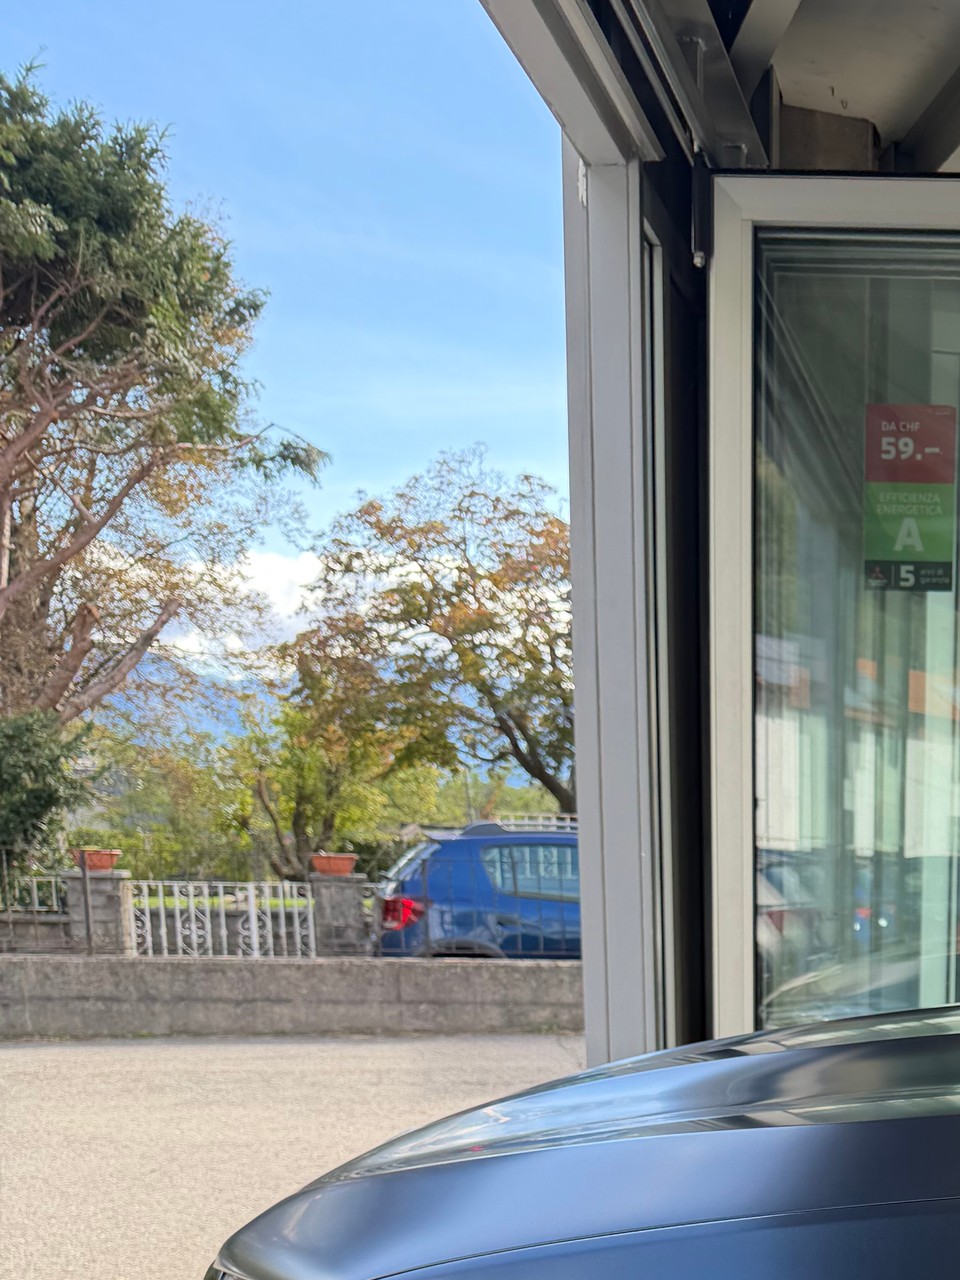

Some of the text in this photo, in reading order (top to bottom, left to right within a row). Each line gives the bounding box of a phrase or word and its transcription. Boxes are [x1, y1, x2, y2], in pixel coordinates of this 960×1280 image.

[881, 421, 921, 433] DA CHF
[879, 491, 941, 504] EFFICIENZA
[876, 504, 944, 516] ENERGETICA
[893, 516, 925, 552] A
[900, 565, 915, 588] 5
